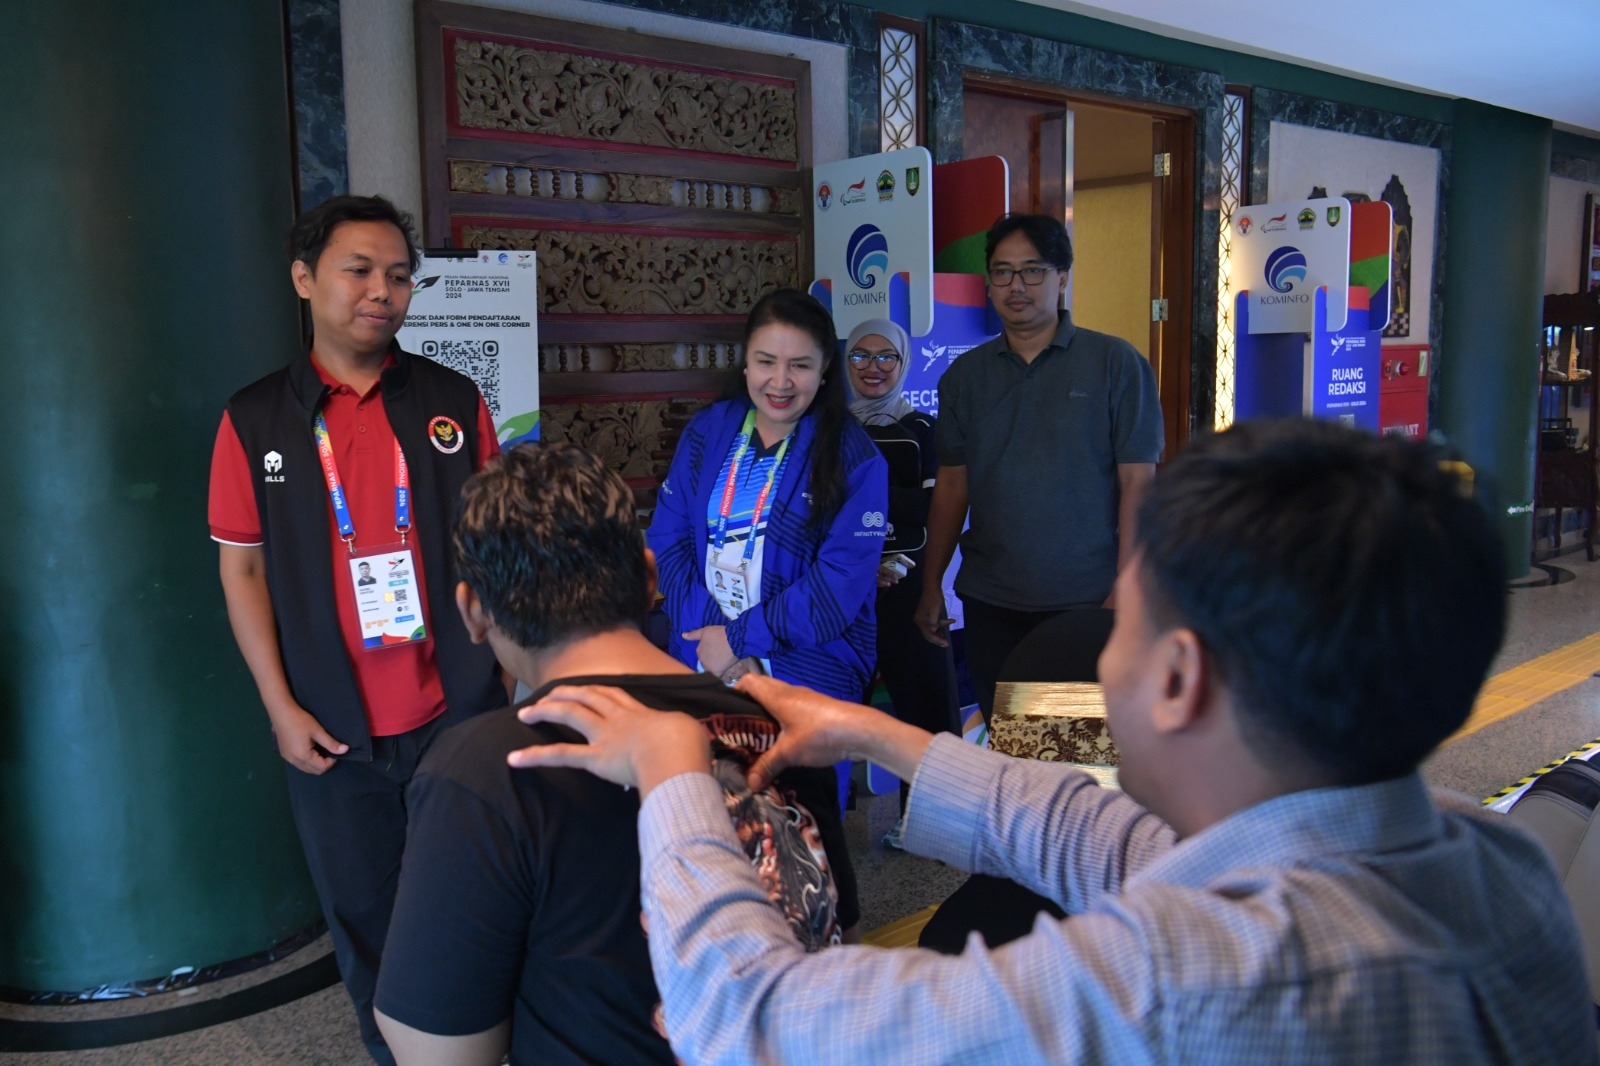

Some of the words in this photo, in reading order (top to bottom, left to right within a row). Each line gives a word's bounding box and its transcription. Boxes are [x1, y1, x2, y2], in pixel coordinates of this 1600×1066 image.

[1260, 294, 1309, 305] KOMINFO
[1332, 367, 1363, 381] RUANG
[1328, 381, 1366, 395] REDAKSI
[320, 439, 329, 457] SOLO
[328, 472, 343, 509] PEPARNAS
[721, 486, 734, 516] NASIONAL
[749, 510, 761, 542] PEPARNAS
[760, 482, 770, 497] SOLO
